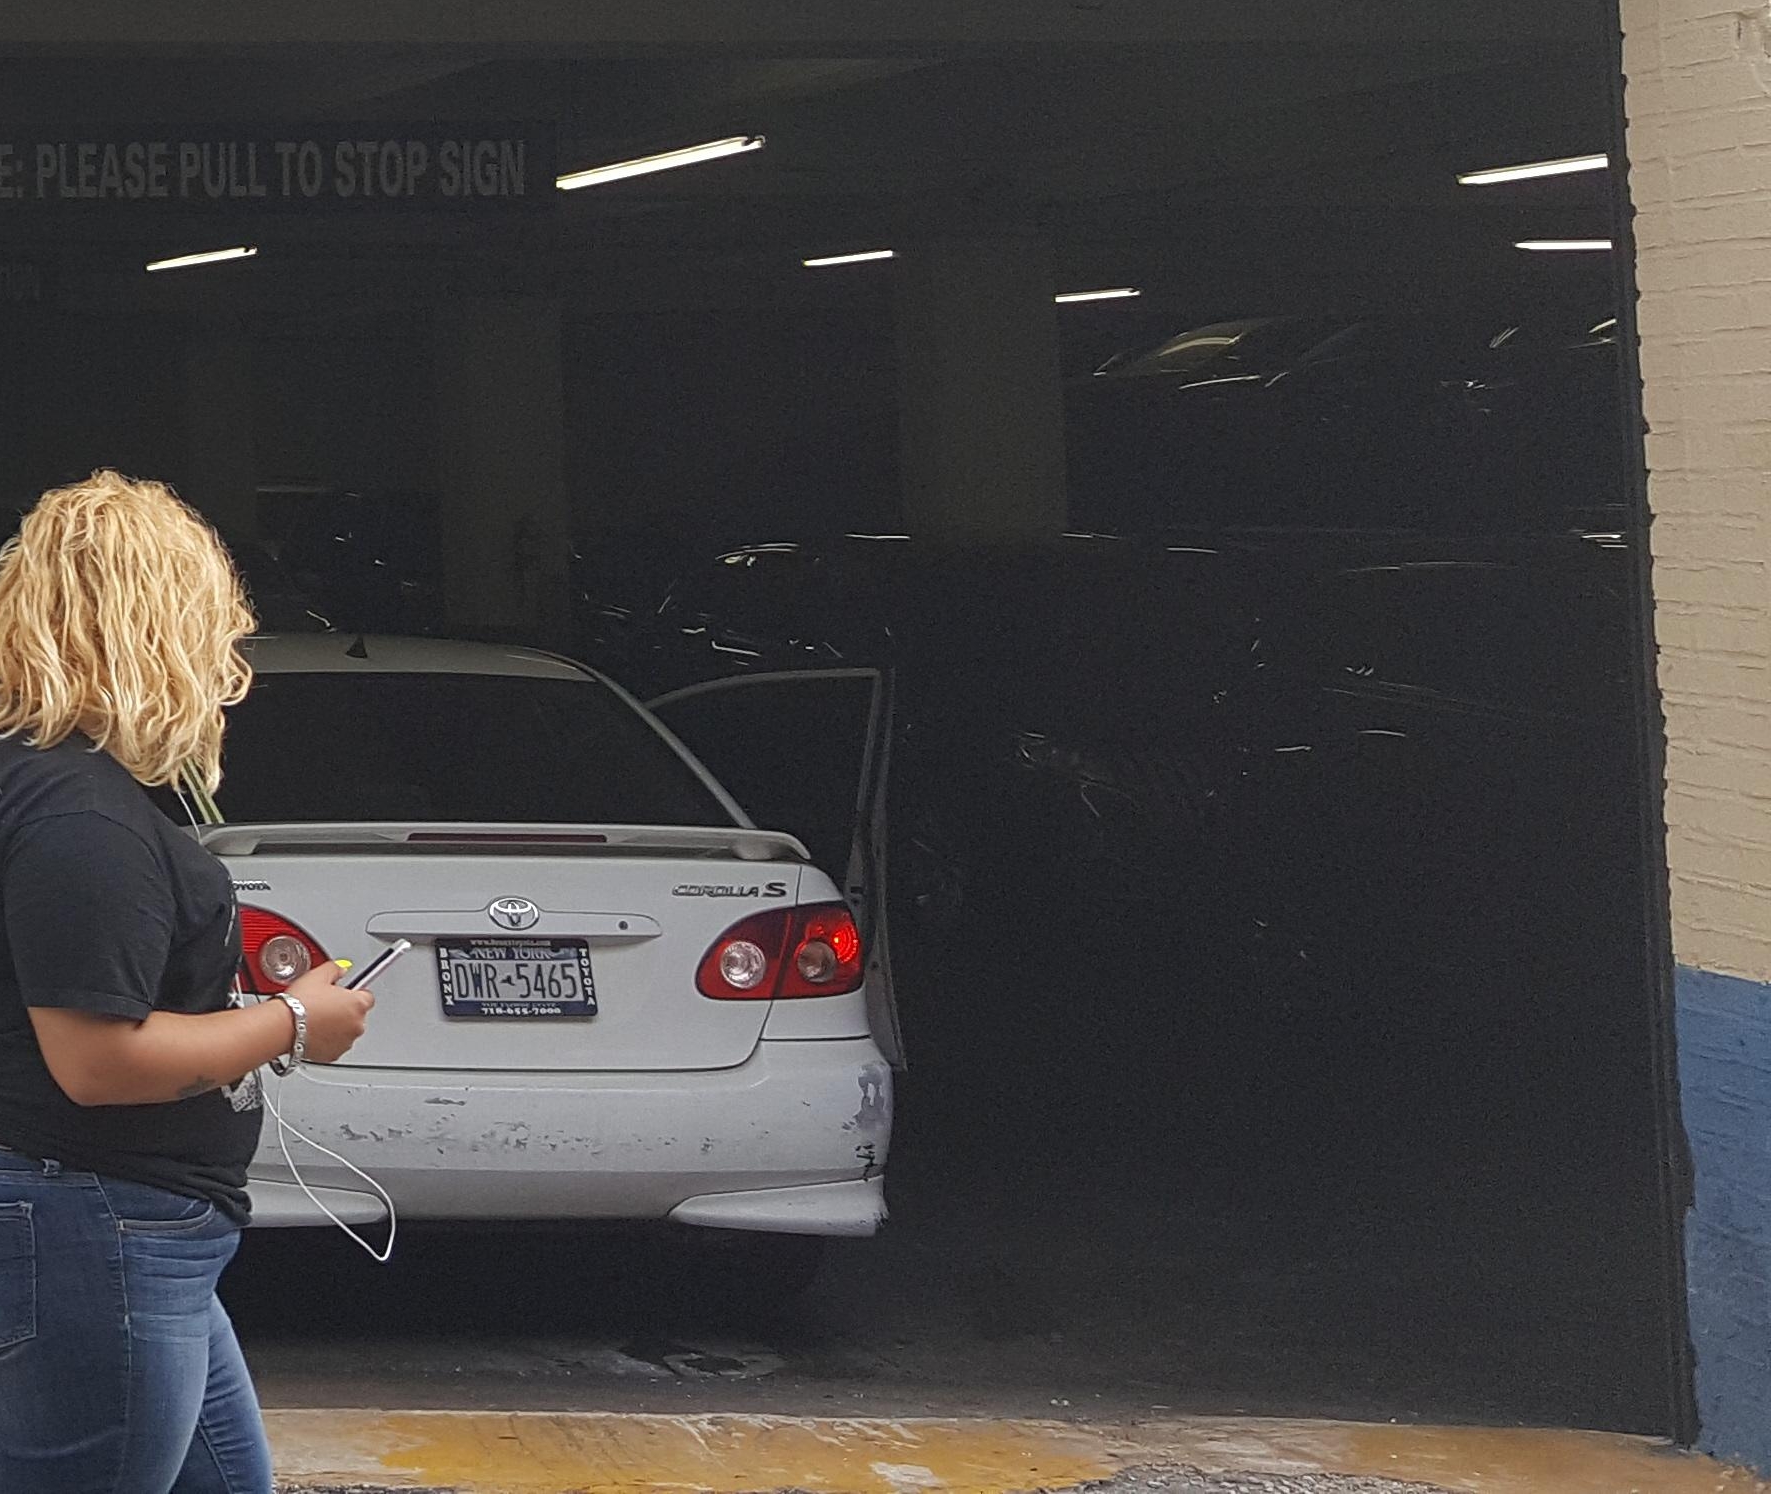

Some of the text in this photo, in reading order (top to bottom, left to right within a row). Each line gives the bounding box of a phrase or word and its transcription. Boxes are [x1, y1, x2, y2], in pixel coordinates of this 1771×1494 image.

[36, 143, 170, 199] PLEASE
[180, 142, 267, 198] PULL
[275, 141, 320, 197] TO
[334, 141, 428, 197] STOP
[439, 139, 527, 197] SIGN
[232, 880, 272, 891] OYOTA
[671, 881, 788, 898] COROLLA S
[473, 946, 553, 960] NEW YORK
[439, 947, 455, 1006] BRONX
[578, 947, 596, 1006] TOYOTA
